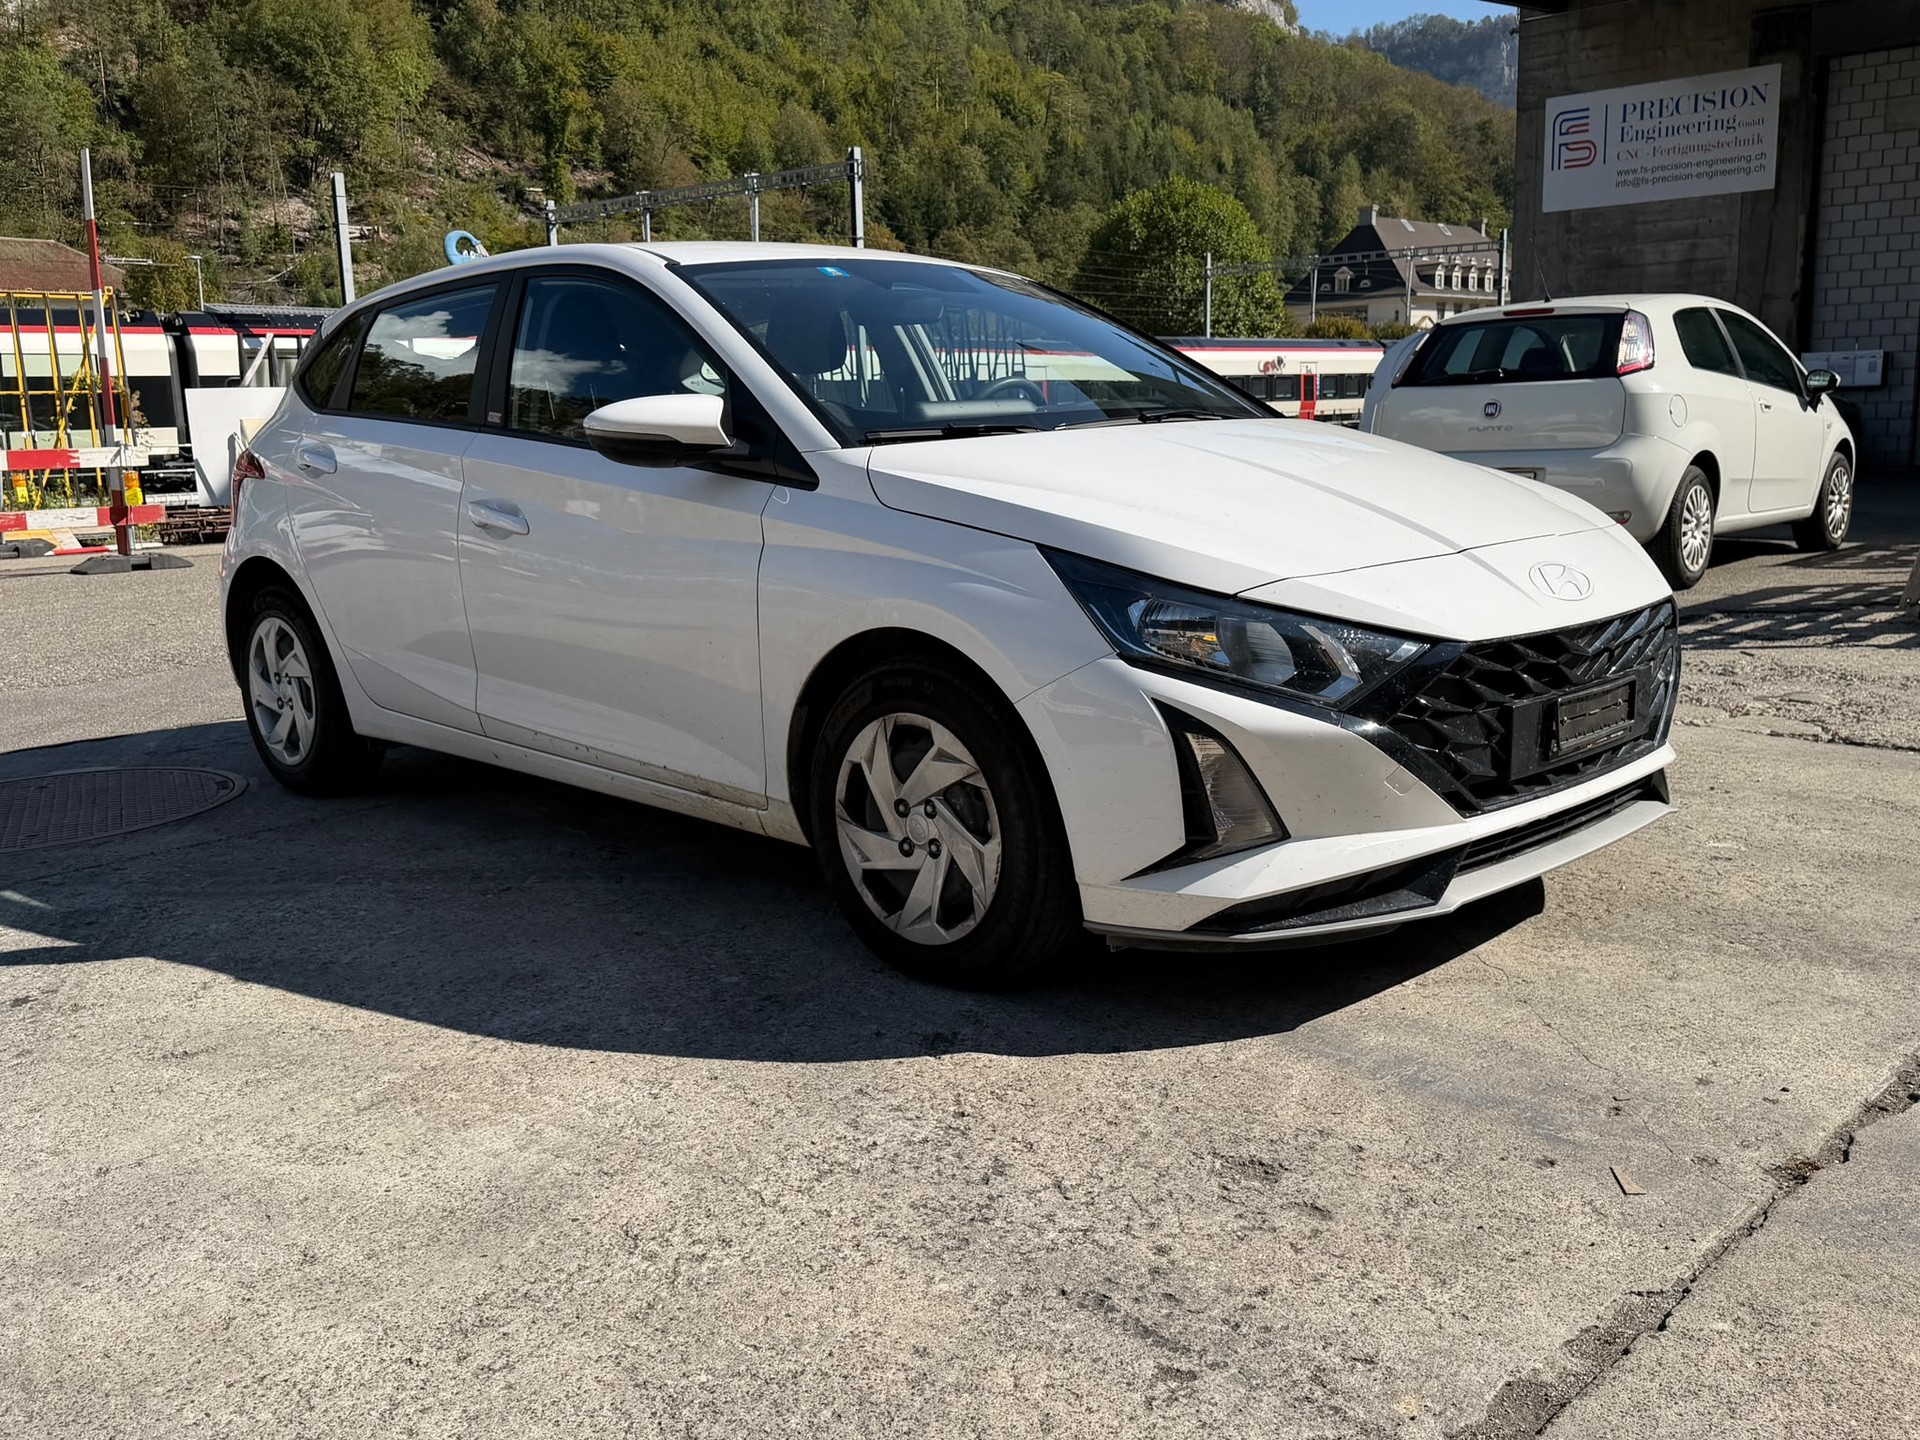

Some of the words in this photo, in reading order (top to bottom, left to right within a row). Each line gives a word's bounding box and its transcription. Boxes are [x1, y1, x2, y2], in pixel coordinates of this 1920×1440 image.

[1620, 83, 1769, 123] PRECISION
[1620, 114, 1737, 144] Engineering
[1615, 163, 1766, 188] info@fs-precision-engineering.ch
[1616, 151, 1767, 177] www.fs-precision-engineering.ch
